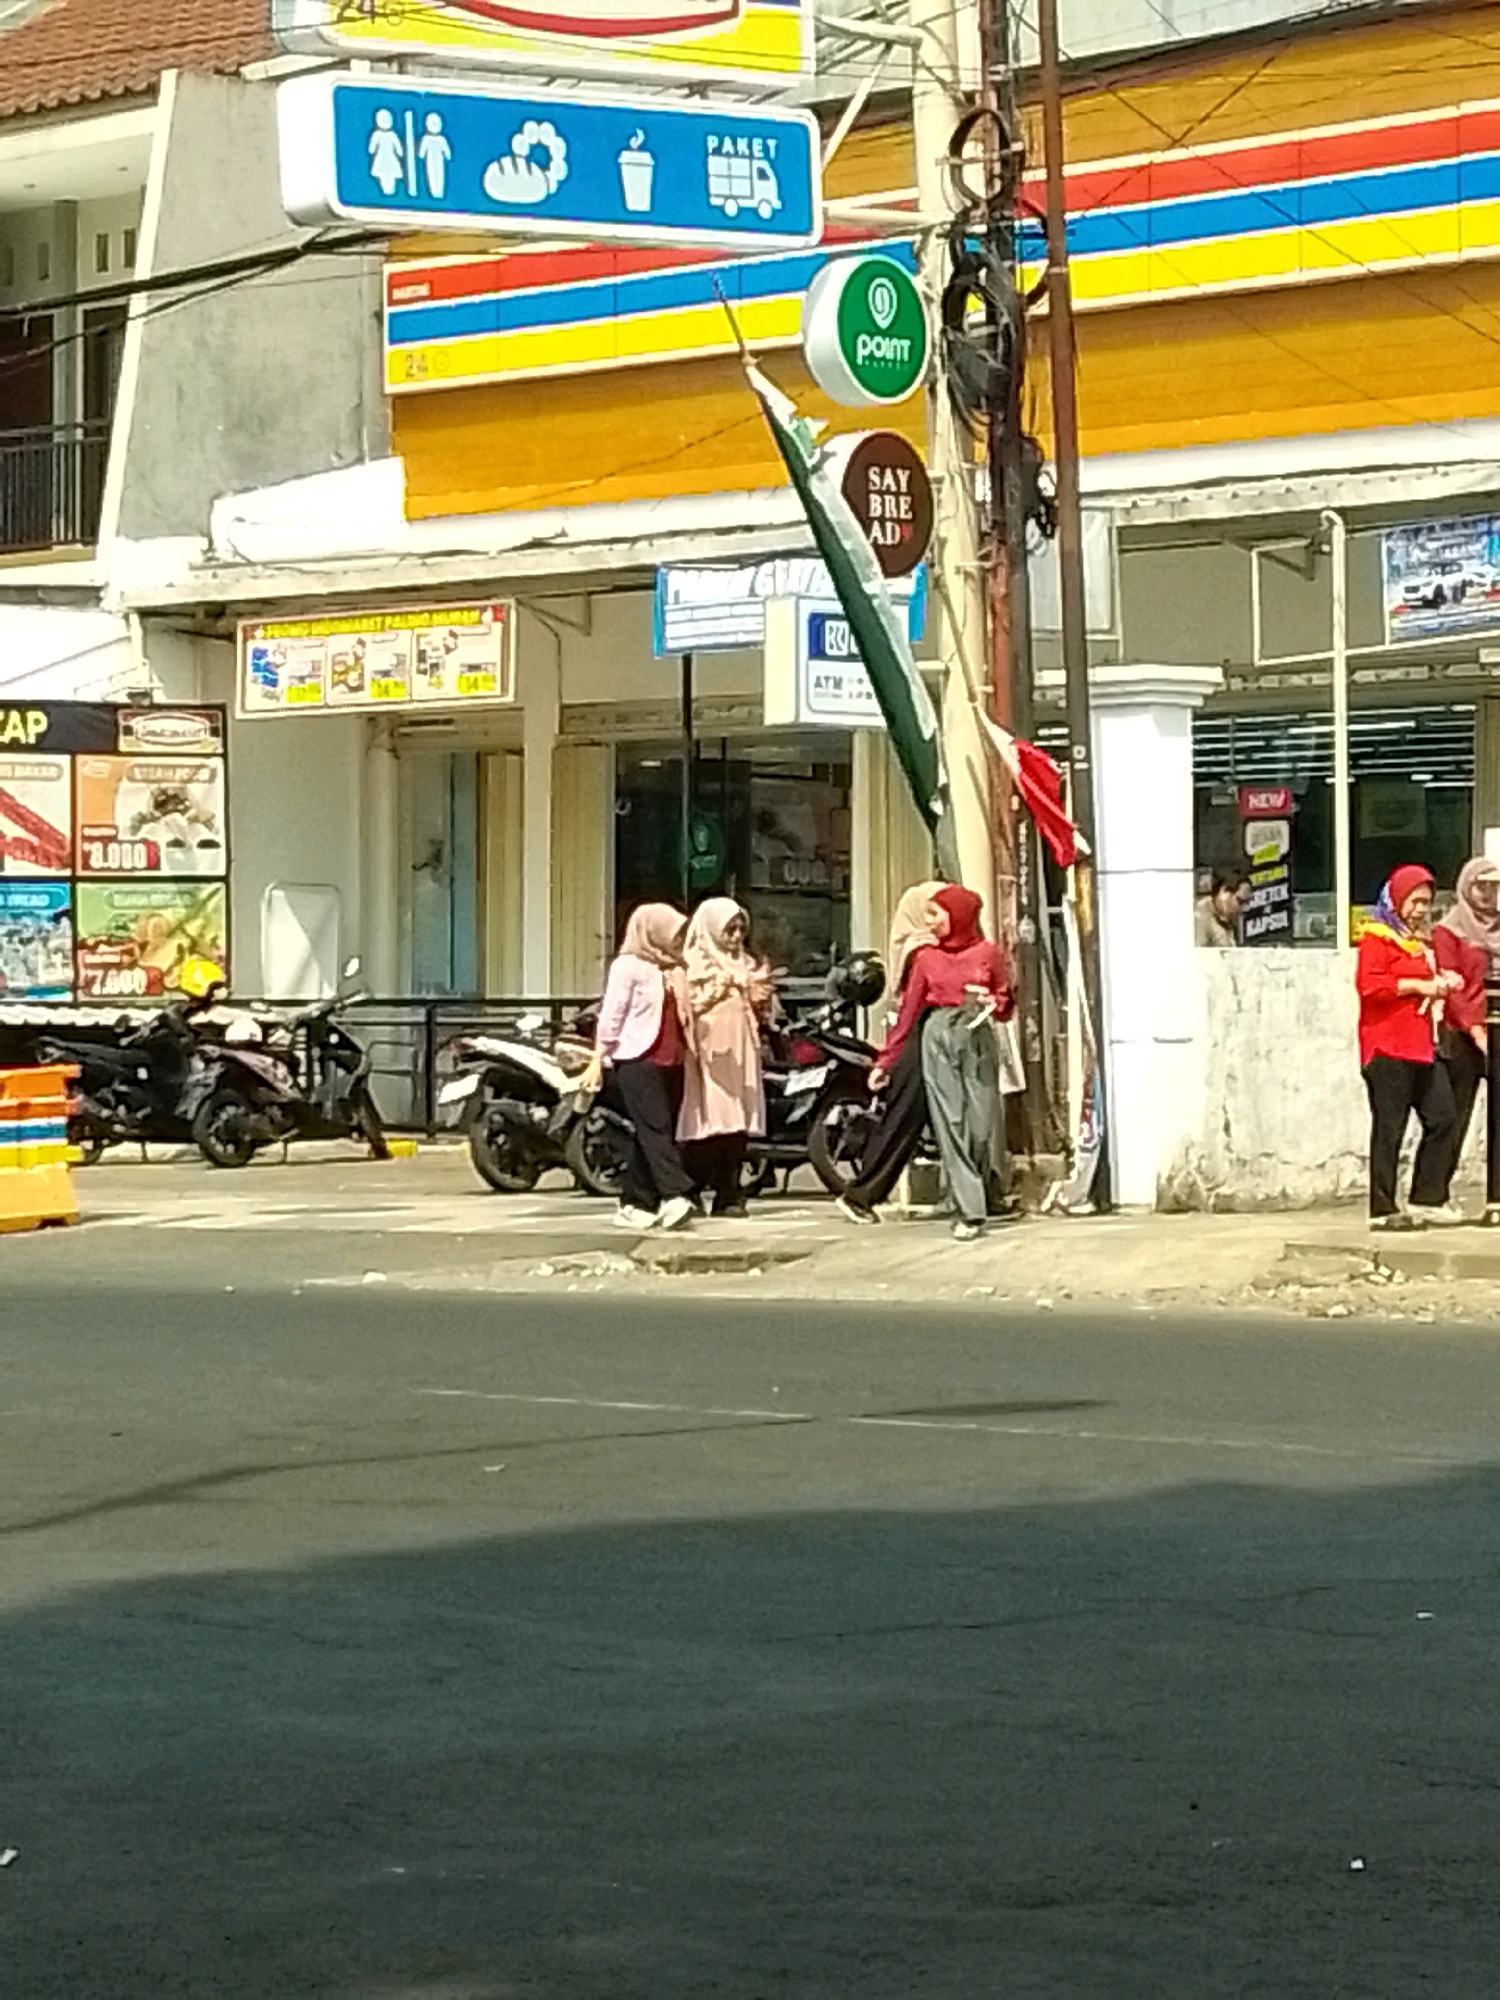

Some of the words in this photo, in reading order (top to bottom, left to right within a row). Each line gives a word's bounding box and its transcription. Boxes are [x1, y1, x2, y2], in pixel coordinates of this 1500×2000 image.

[706, 135, 778, 160] PAKET
[868, 466, 911, 493] SAY
[868, 493, 913, 520] BRE
[869, 520, 900, 546] AD
[813, 675, 844, 690] ATM
[0, 709, 49, 745] AP
[1248, 792, 1286, 809] NEW
